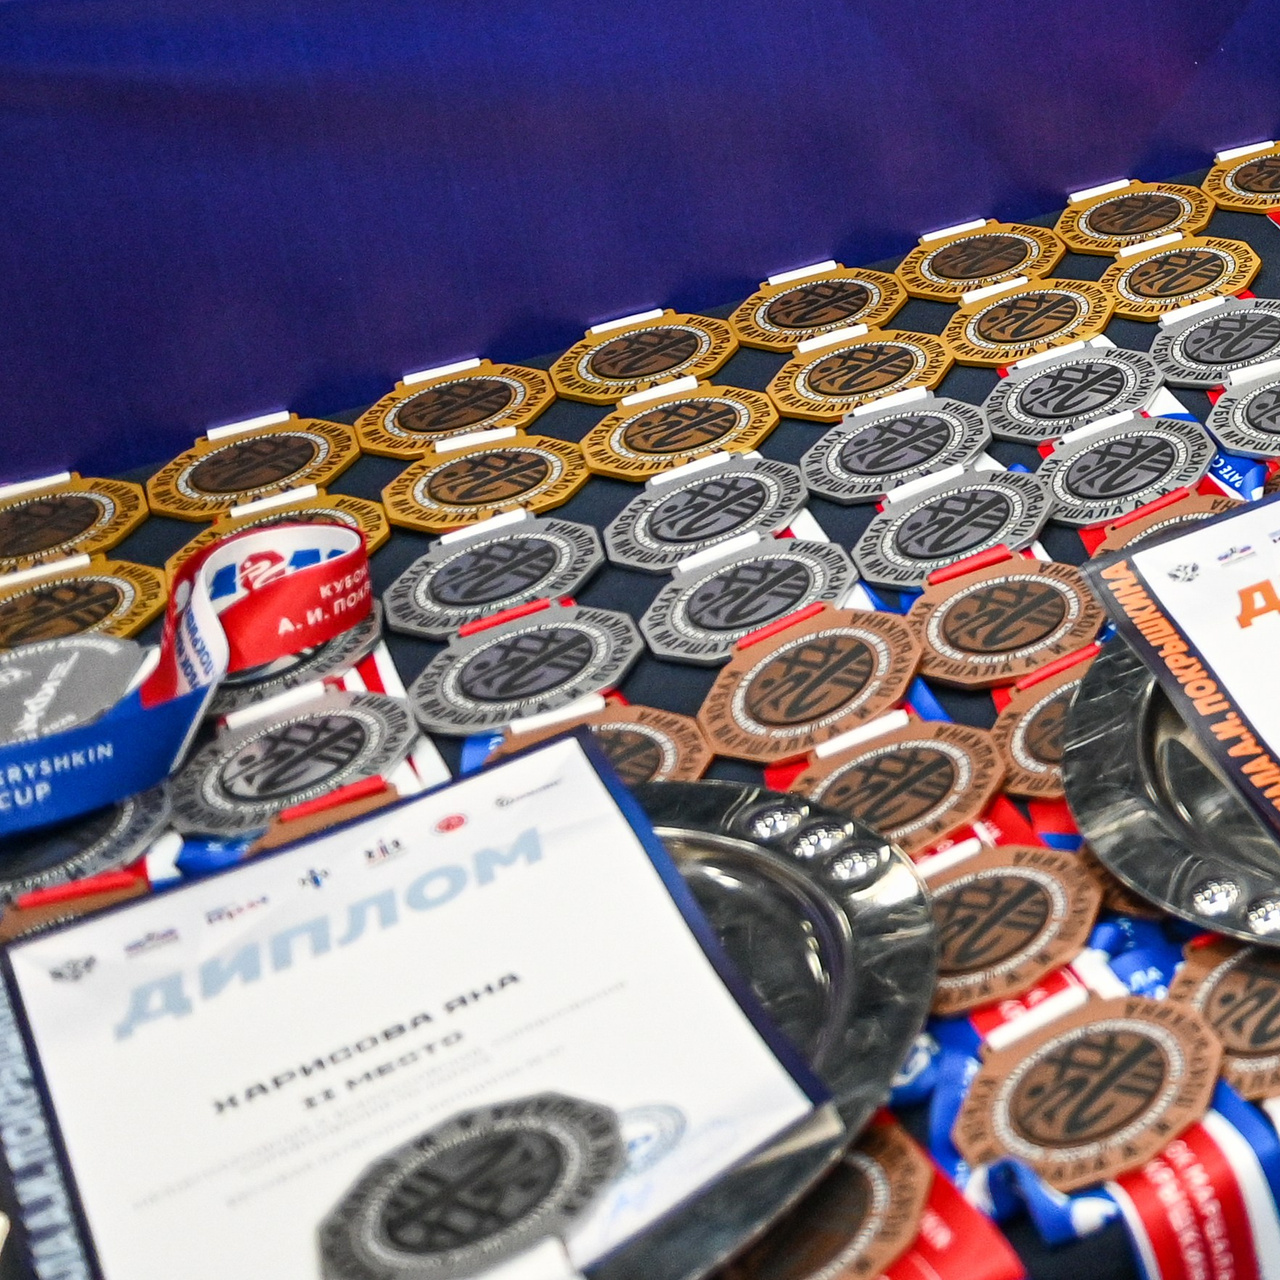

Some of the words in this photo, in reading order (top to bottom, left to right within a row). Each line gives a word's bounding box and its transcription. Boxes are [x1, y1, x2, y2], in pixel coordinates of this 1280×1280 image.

[1156, 184, 1213, 225] ПОКРЫШКИНА
[1010, 224, 1058, 270] ПОКРЫШКИНА
[1205, 238, 1255, 288] ПОКРЫШКИНА
[1054, 280, 1108, 328] ПОКРЫШКИНА
[947, 314, 970, 344] КУБОК
[954, 342, 1038, 360] МАРШАЛА
[561, 374, 639, 395] МАРШАЛА
[686, 316, 733, 370] ПОКРЫШКИНА
[1104, 348, 1157, 405] ПОКРЫШКИНА
[591, 446, 675, 470] МАРШАЛА
[722, 388, 773, 444] ПОКРЫШКИНА
[1213, 396, 1237, 433] КУБОК
[391, 497, 480, 523] МАРШАЛА
[536, 438, 586, 497] ПОКРЫШКИНА
[276, 616, 303, 635] А.
[306, 607, 331, 624] И.
[1101, 560, 1231, 716] ПОКРЫШКИНА
[111, 826, 548, 1045] ДИПЛОМ
[443, 972, 522, 1014] ЯНА
[345, 1030, 464, 1091] МЕСТО
